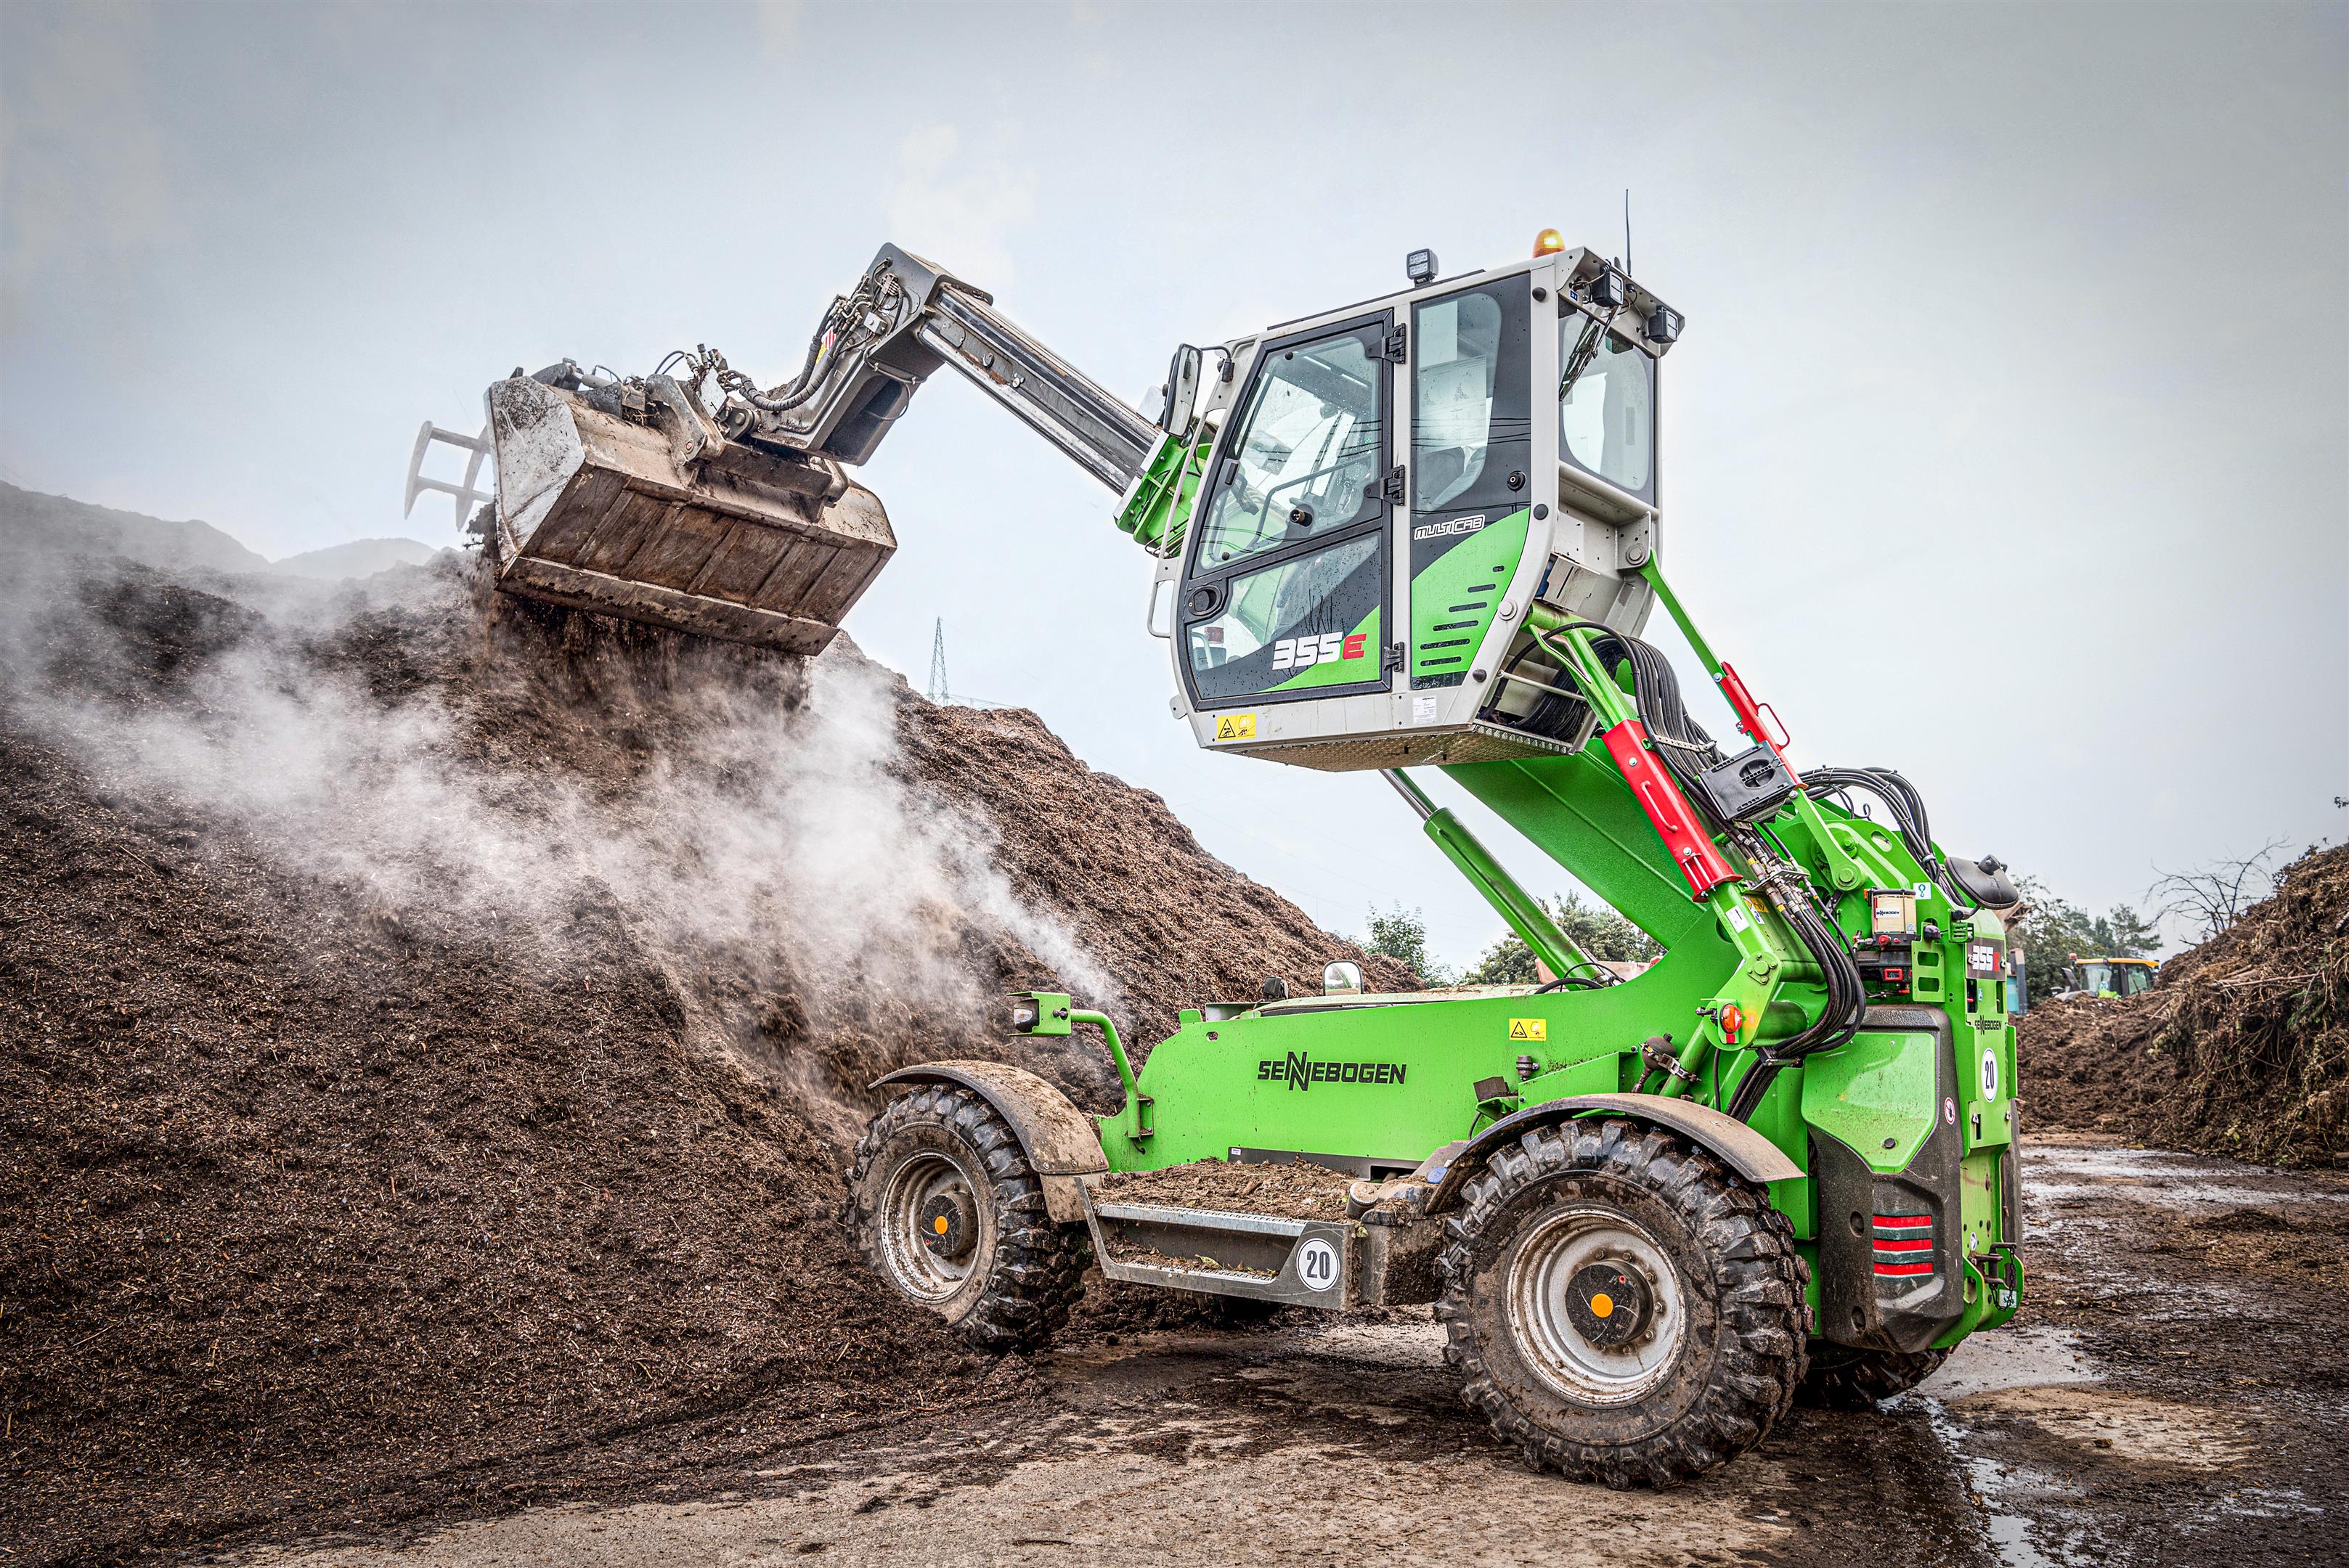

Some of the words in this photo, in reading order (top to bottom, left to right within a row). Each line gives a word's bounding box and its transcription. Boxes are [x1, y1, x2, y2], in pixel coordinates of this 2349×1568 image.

[1414, 514, 1486, 541] MULTICAB
[1272, 632, 1367, 671] 355E
[1972, 945, 2000, 971] 355E
[1975, 1015, 2002, 1035] SENNEBOGEN
[1257, 1051, 1407, 1092] SENNEBOGEN
[1985, 1061, 1994, 1089] 20
[1306, 1249, 1330, 1280] 20
